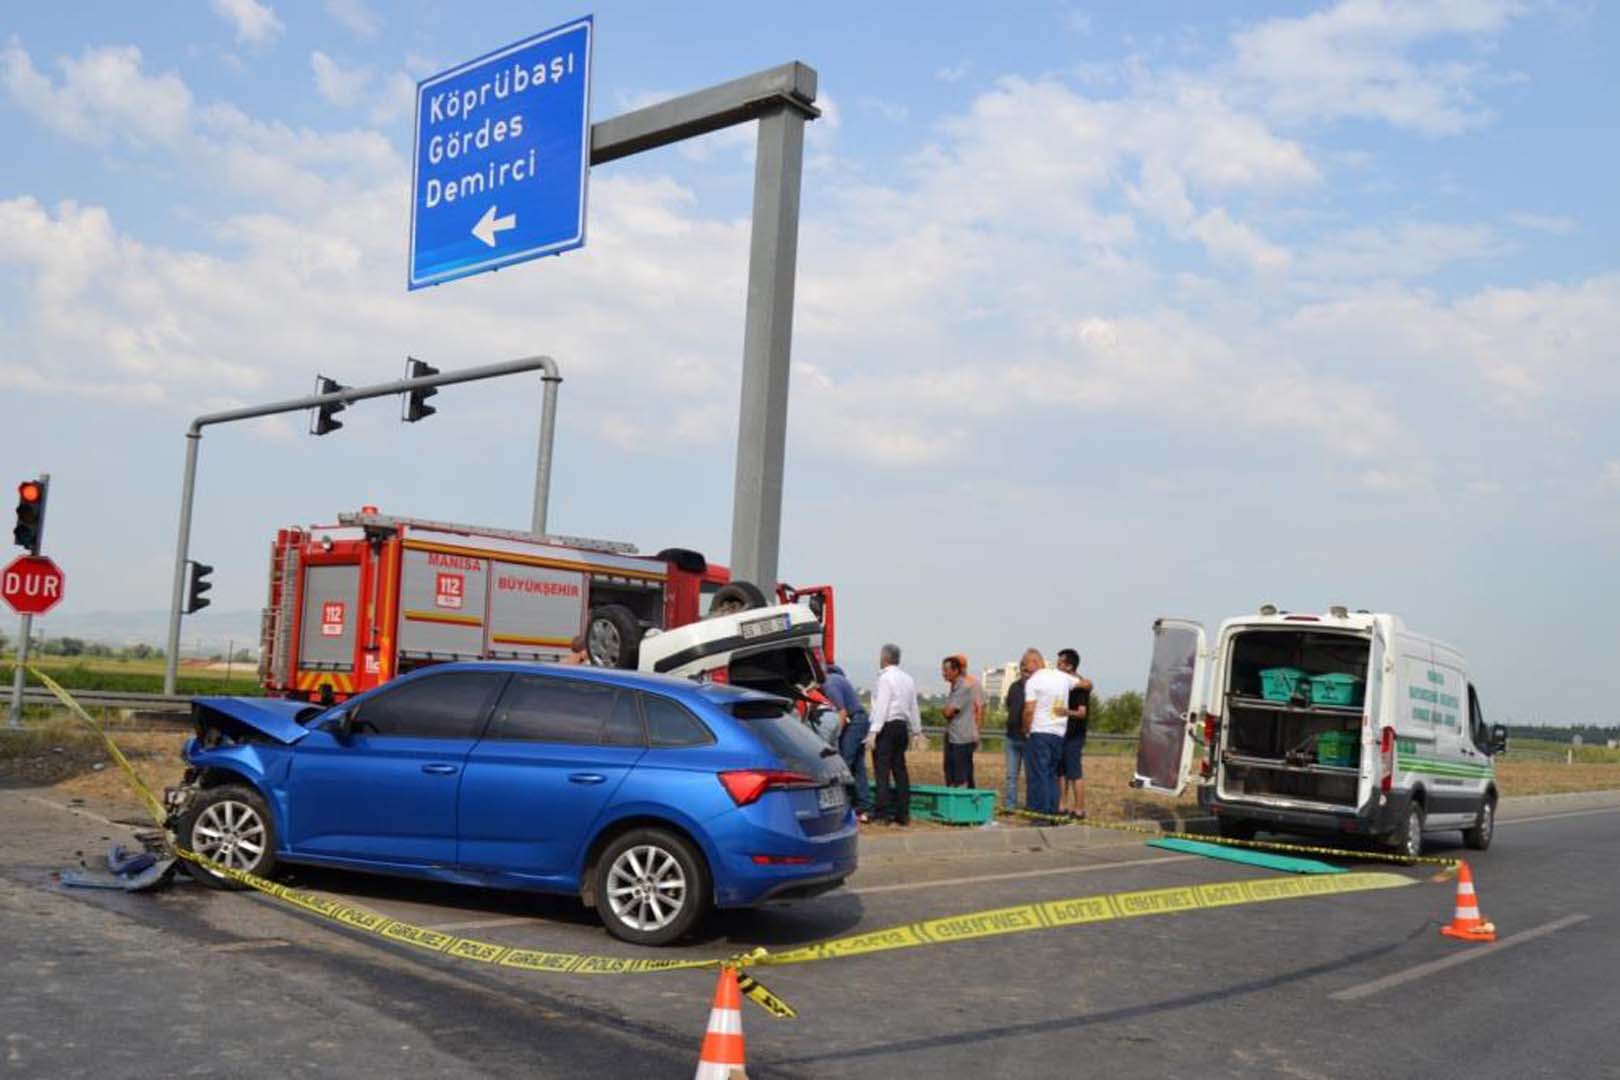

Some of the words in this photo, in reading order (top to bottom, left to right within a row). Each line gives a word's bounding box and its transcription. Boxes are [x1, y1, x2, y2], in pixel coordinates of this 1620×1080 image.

[430, 53, 573, 123] Köprübaşı
[429, 115, 523, 164] Gördes
[426, 150, 535, 208] Demirci
[5, 572, 59, 598] DUR
[441, 577, 460, 594] 112
[326, 606, 342, 622] 112
